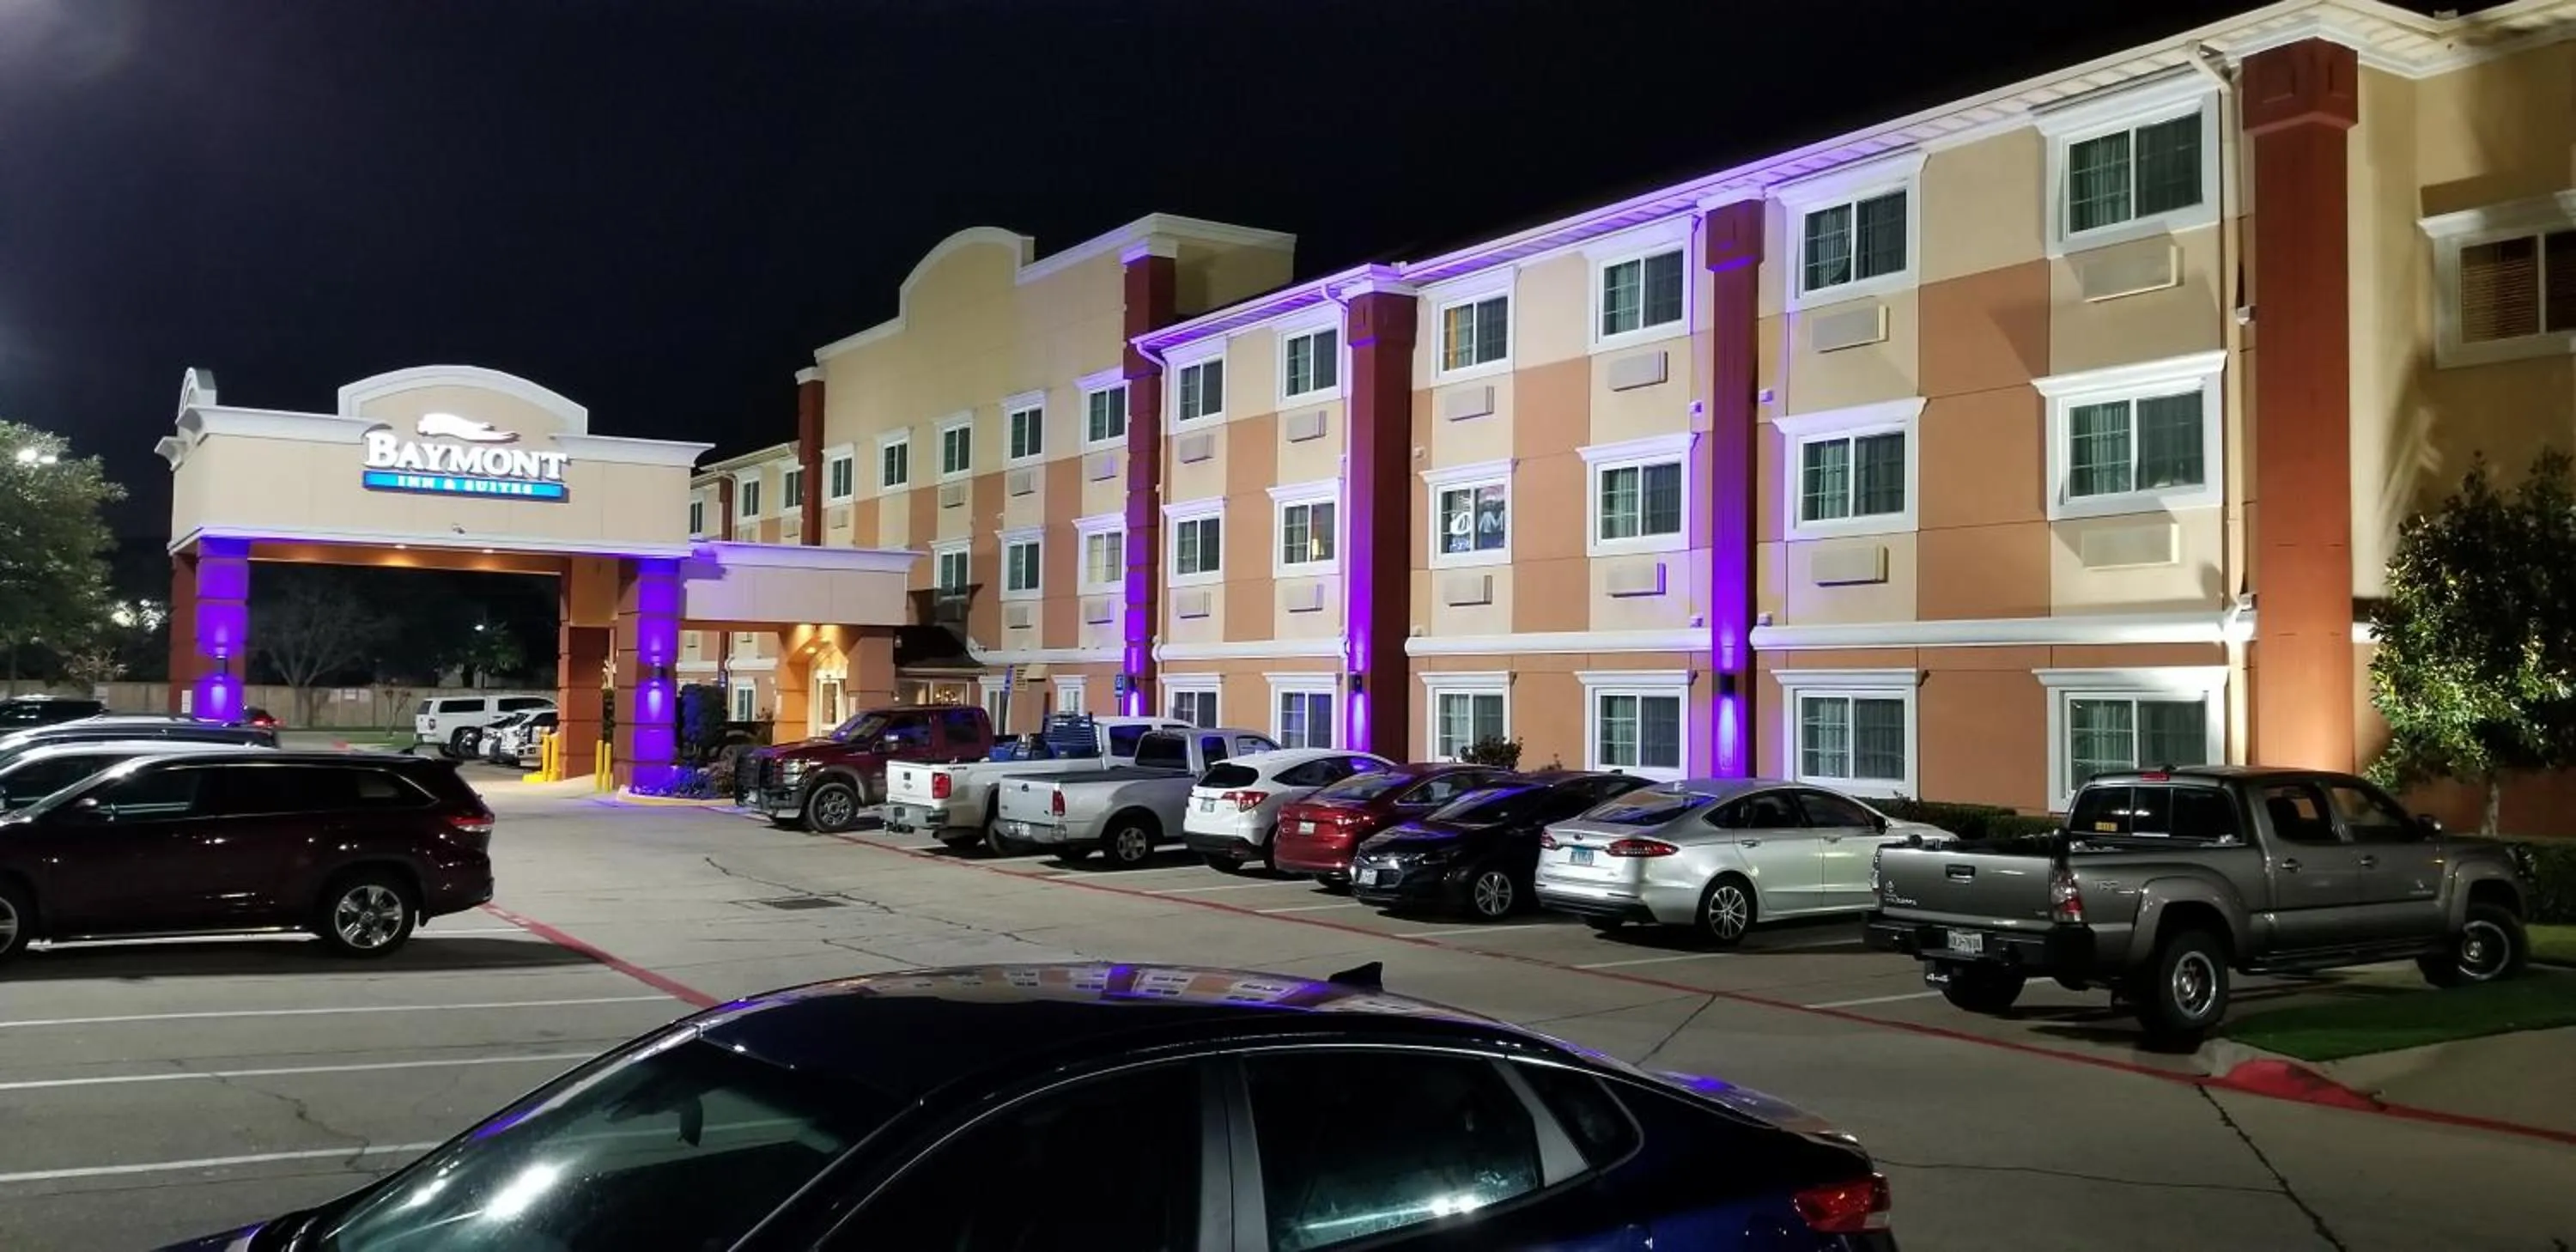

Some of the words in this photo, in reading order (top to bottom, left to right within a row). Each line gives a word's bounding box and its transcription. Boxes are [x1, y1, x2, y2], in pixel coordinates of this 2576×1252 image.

[364, 431, 568, 480] BAYMONT
[398, 475, 435, 489] INN
[463, 479, 533, 495] SUITES
